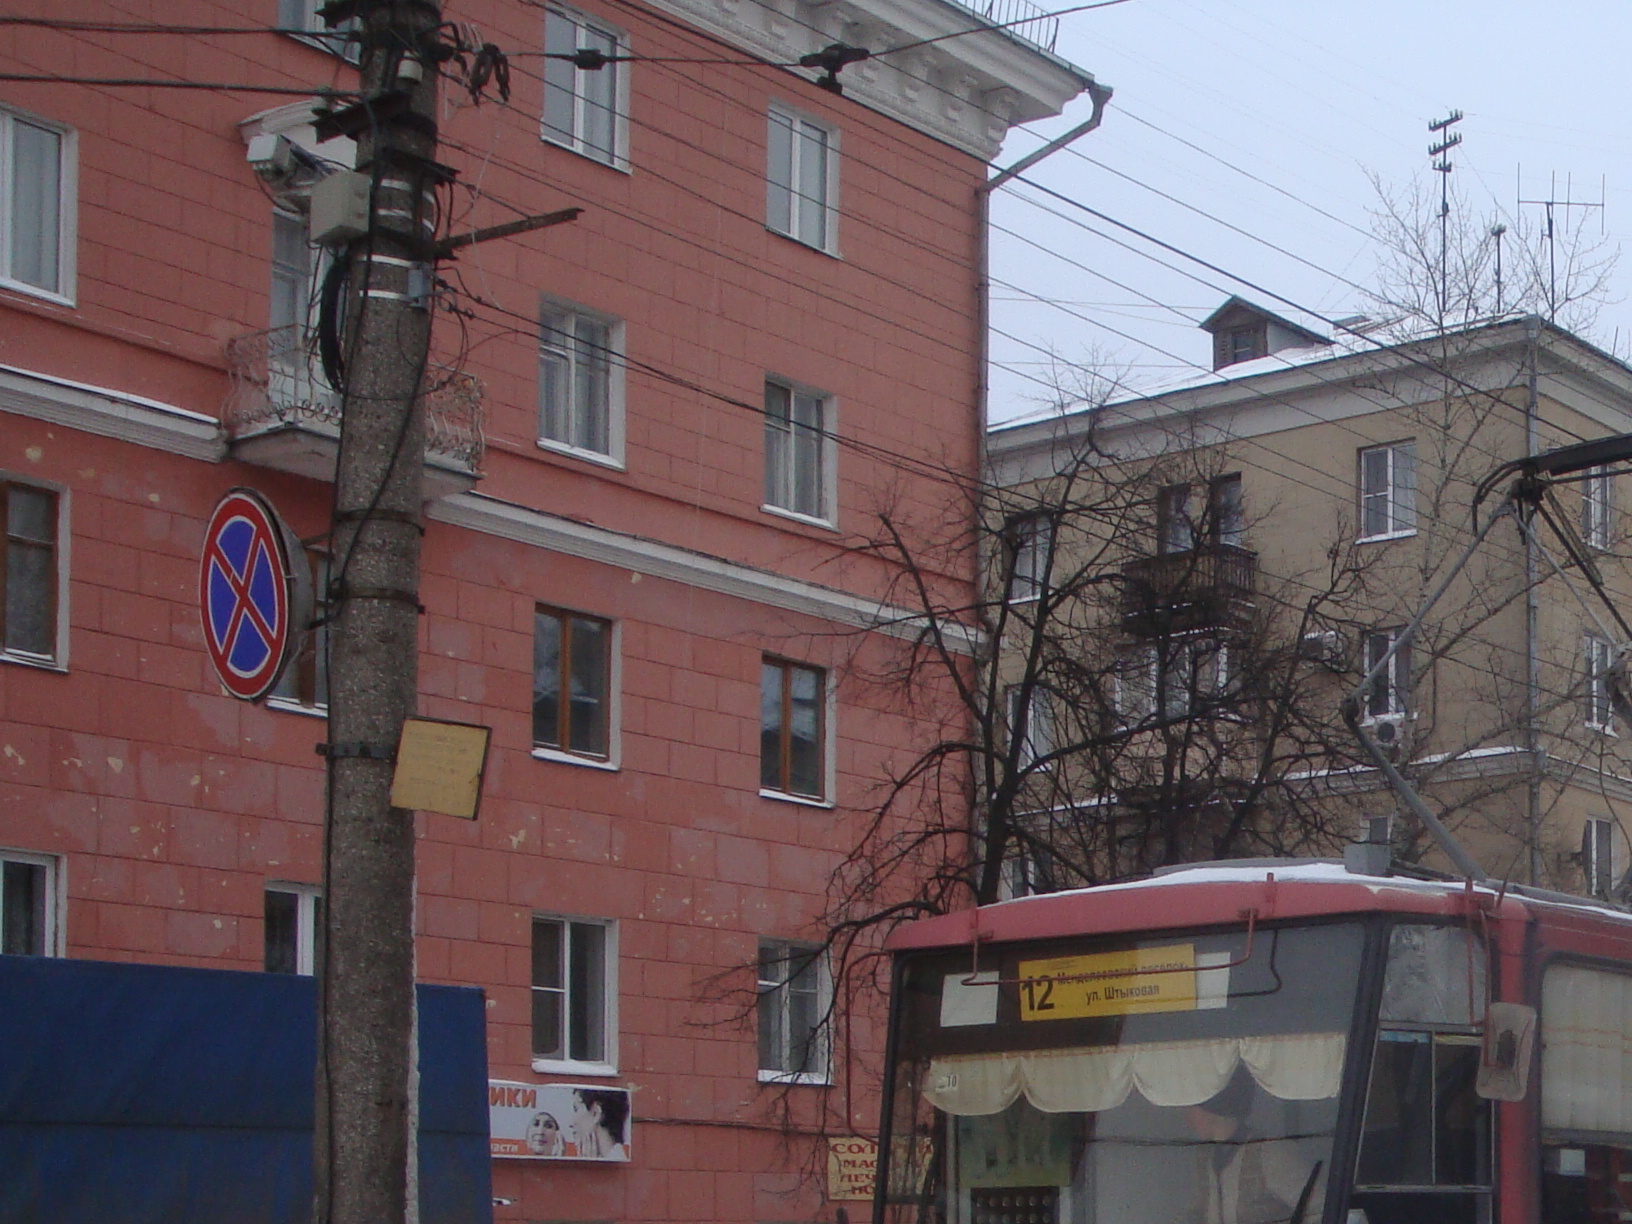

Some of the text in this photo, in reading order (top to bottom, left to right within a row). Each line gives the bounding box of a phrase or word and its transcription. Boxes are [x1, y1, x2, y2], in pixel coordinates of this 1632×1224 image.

[1021, 975, 1055, 1011] 12
[1086, 984, 1160, 1006] ул. Штыковая
[488, 1086, 537, 1109] ИКИ
[491, 1143, 518, 1153] асти
